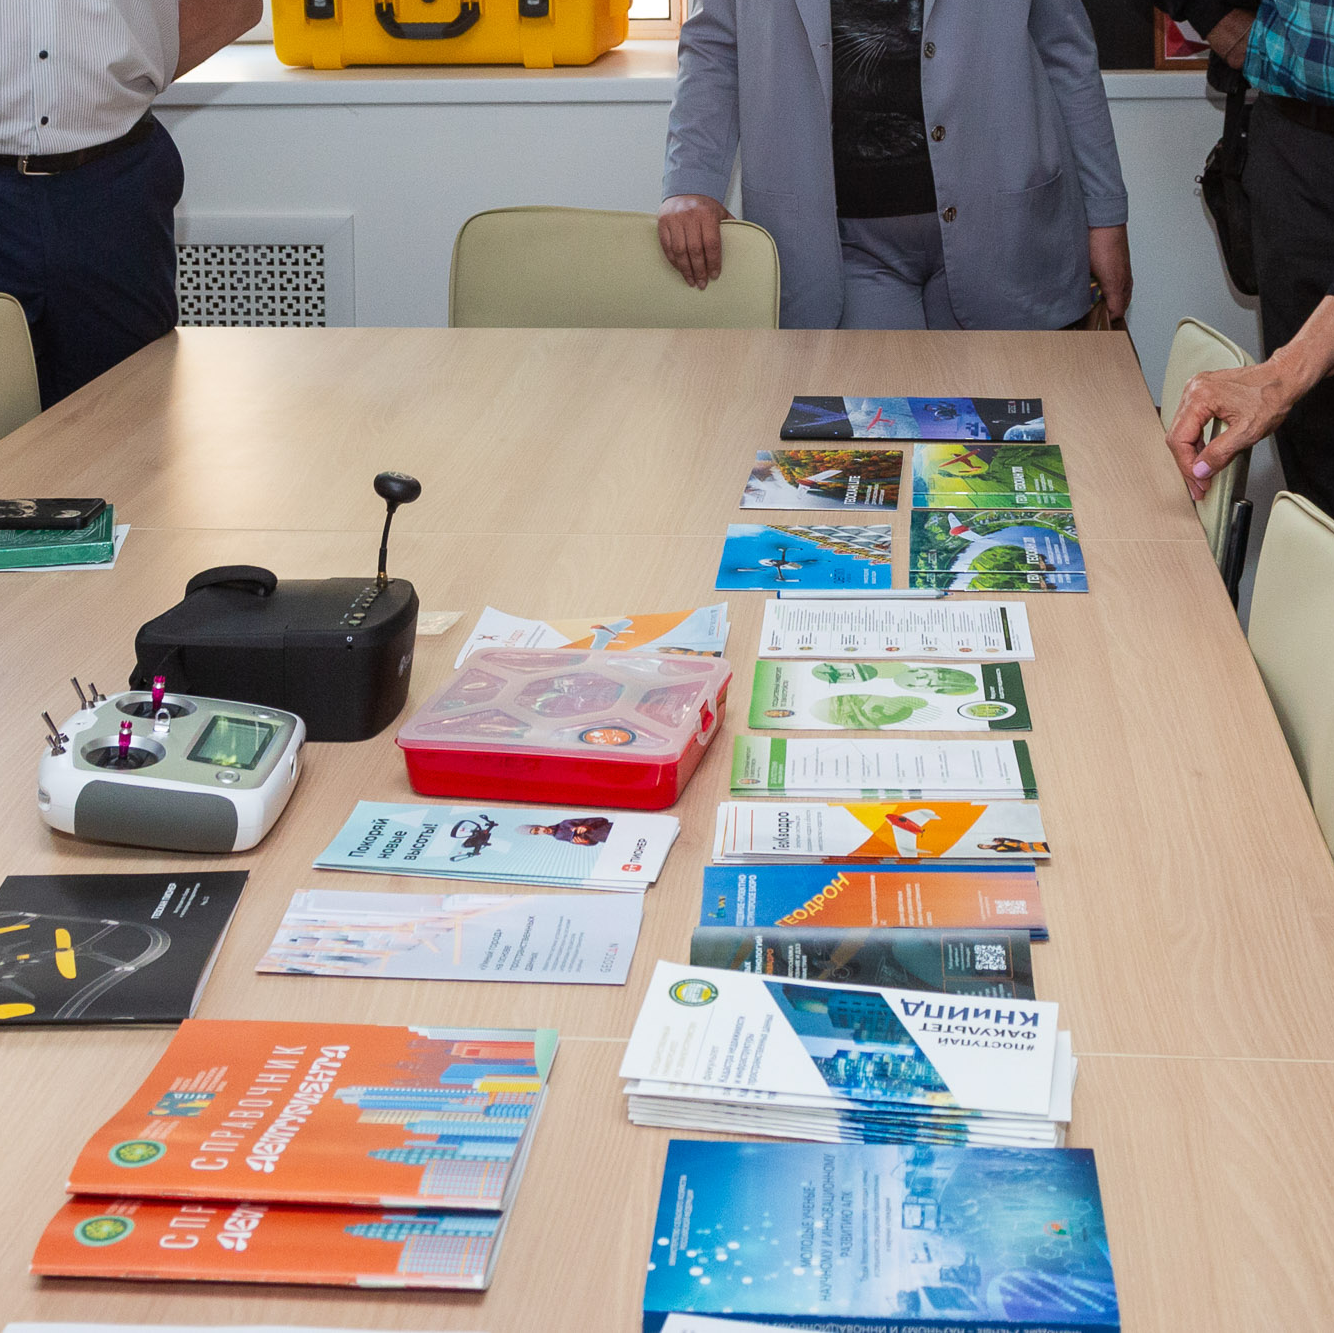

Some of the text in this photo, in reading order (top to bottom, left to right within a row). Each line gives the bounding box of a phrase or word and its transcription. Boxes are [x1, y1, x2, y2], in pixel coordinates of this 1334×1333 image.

[347, 818, 390, 858] Покоряй
[377, 830, 408, 859] новые
[403, 823, 439, 861] высоты!
[630, 838, 647, 863] ПИОНЕР
[772, 811, 795, 851] ГеоКвадро
[774, 871, 851, 927] ГЕОДРОН
[599, 942, 619, 973] GEOSCAN
[900, 998, 1040, 1027] КНиИПД
[918, 1022, 1037, 1040] ФАКУЛЬТЕТ
[937, 1037, 1035, 1051] #ПОСТУПАЙ
[190, 1045, 308, 1171] СПРАВОЧНИК
[821, 1153, 836, 1238] ИННОВАЦИОННОМУ
[840, 1190, 854, 1257] РАЗВИТИЮ АПК
[800, 1220, 815, 1268] МОЛОДЫЕ
[819, 1248, 833, 1302] НАУЧНОМУ
